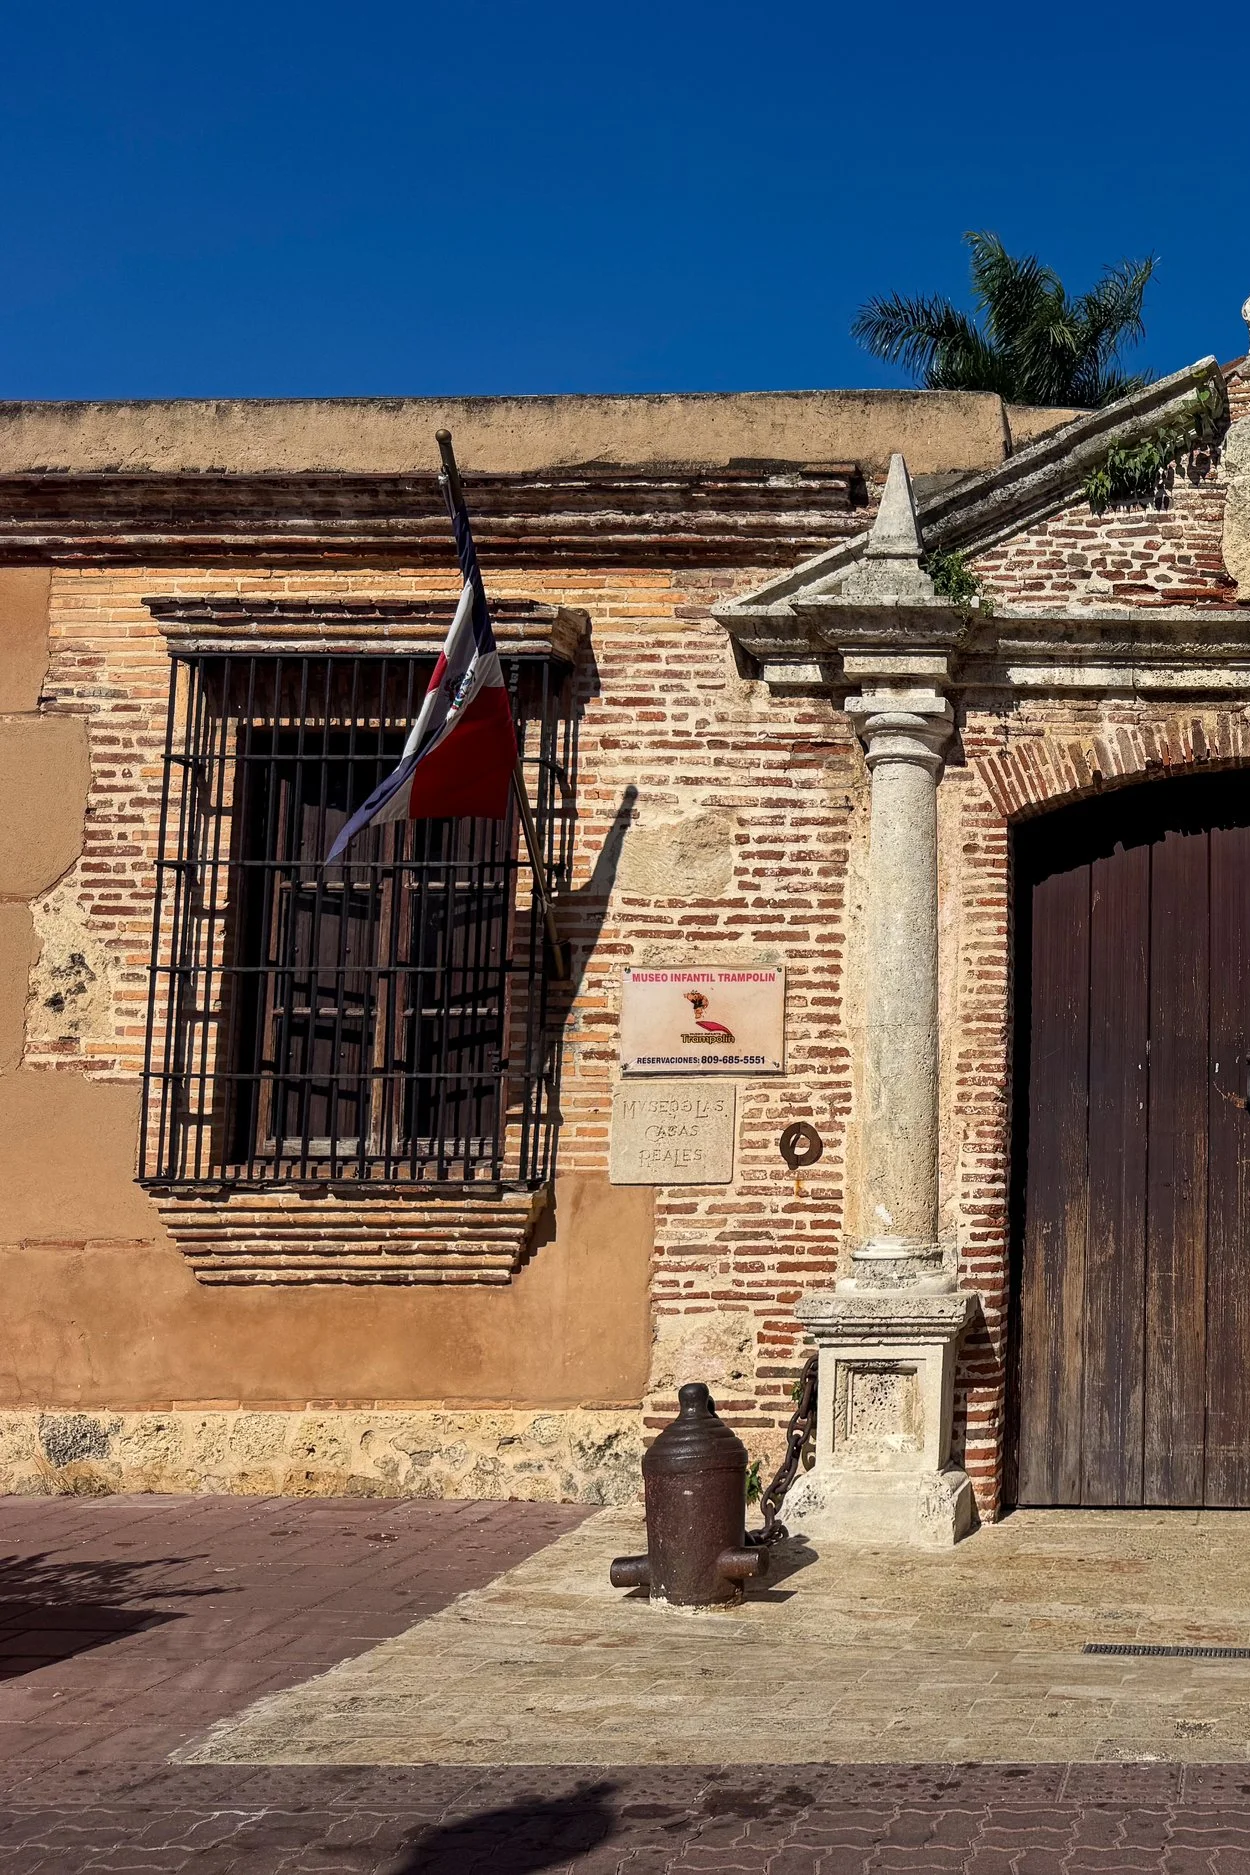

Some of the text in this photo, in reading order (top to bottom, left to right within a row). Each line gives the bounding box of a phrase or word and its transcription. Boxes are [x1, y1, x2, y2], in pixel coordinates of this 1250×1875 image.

[632, 973, 775, 982] MUSEO INFANTIL TRAMPOLIN
[701, 1056, 765, 1064] 809-685-5551
